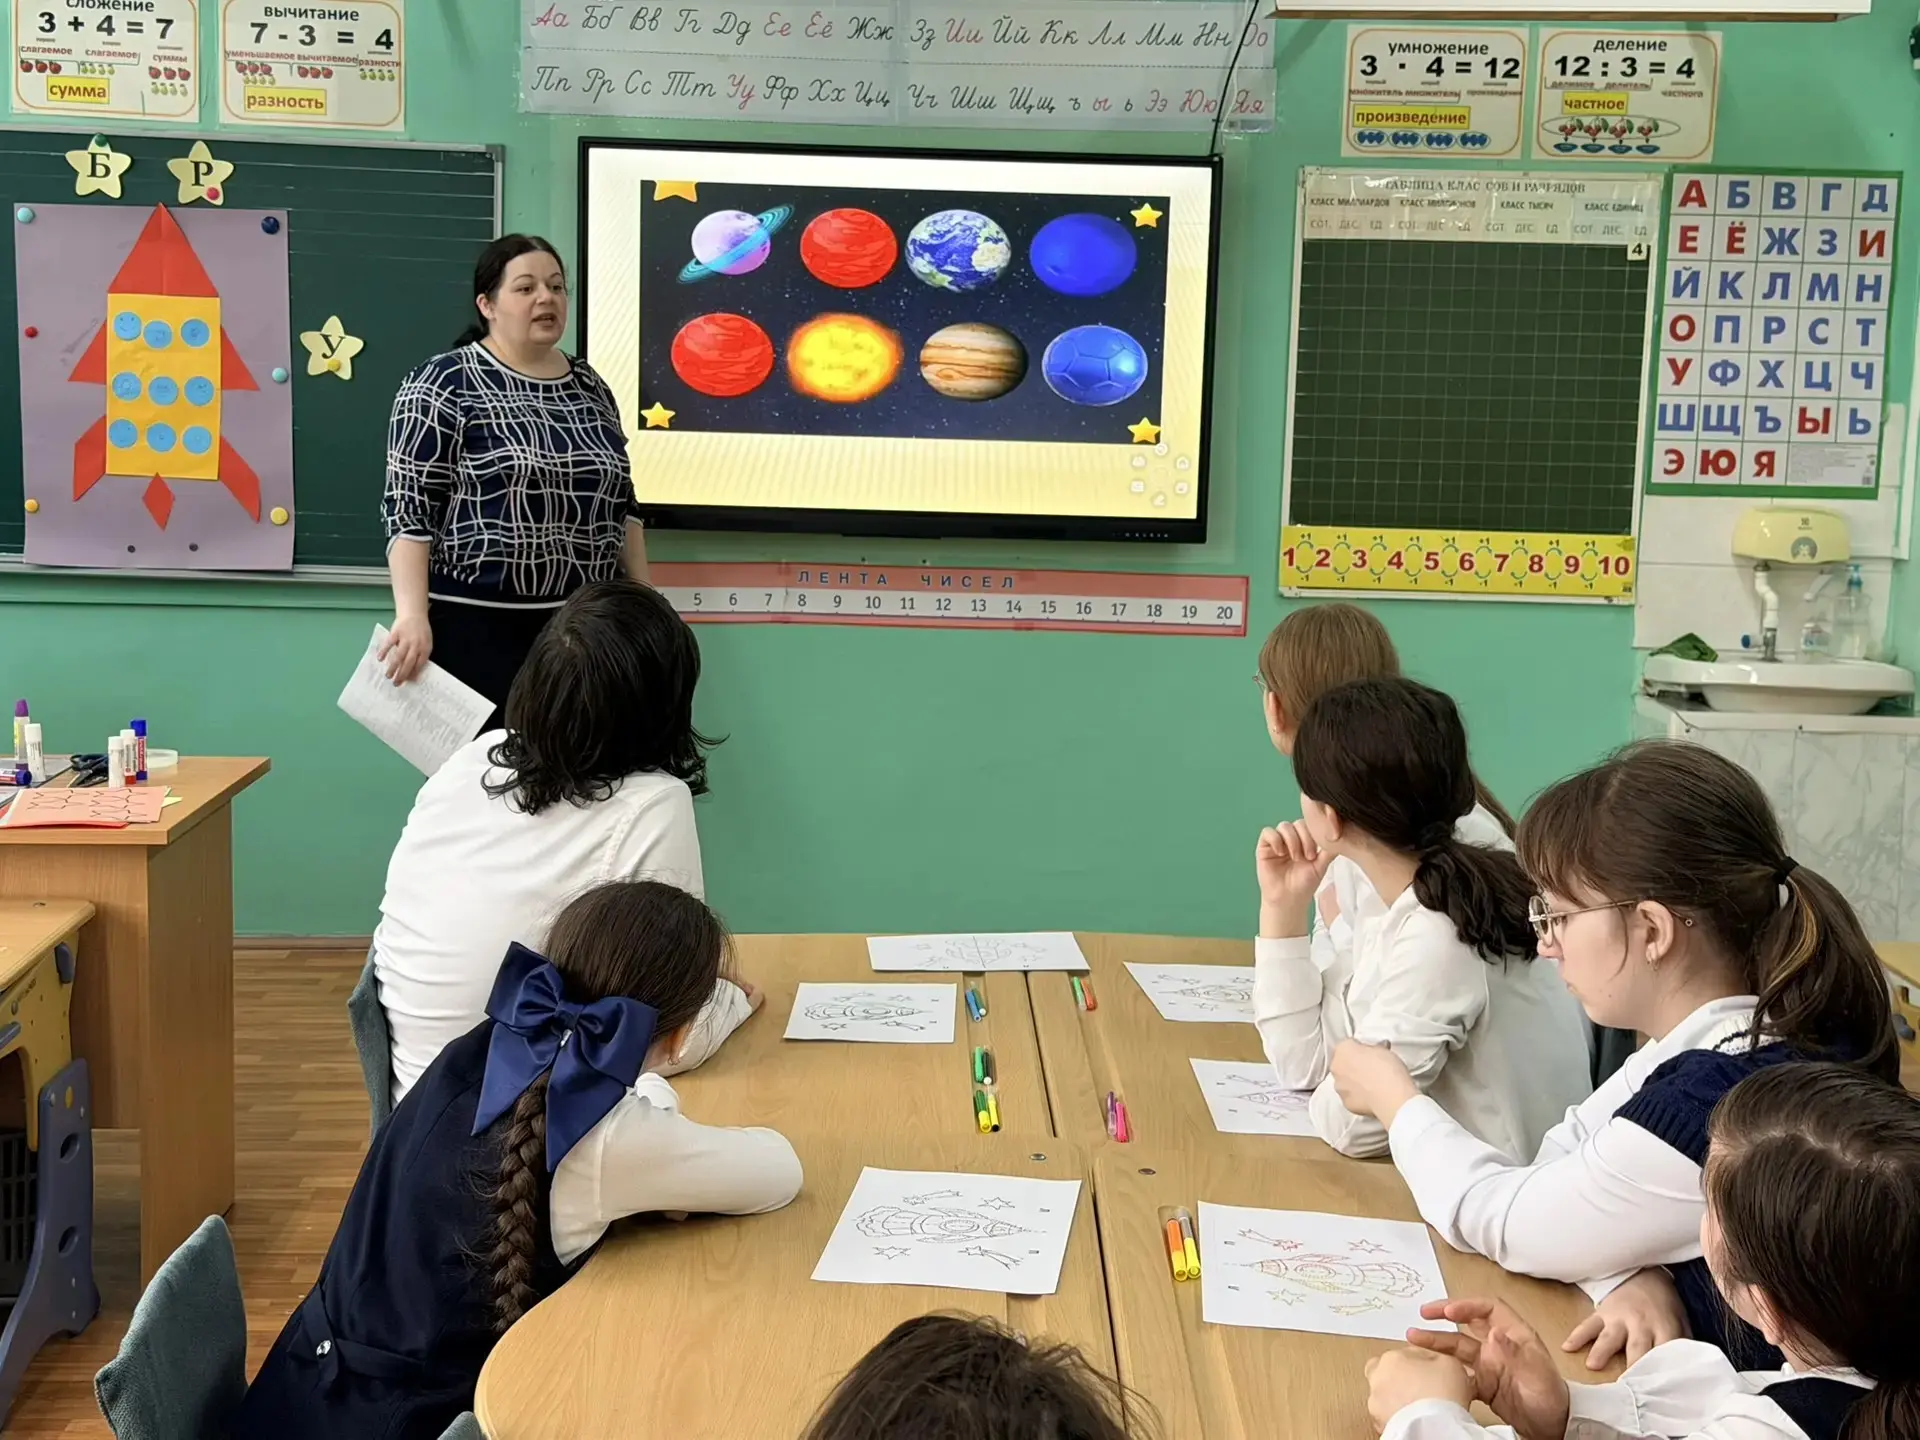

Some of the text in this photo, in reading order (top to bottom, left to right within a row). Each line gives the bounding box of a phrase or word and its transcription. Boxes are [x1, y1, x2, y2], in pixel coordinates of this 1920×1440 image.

[66, 0, 155, 12] сложение
[264, 6, 359, 21] вычитание
[38, 11, 56, 33] 3
[96, 15, 116, 36] 4
[155, 18, 174, 39] 7
[250, 22, 268, 44] 7
[298, 25, 316, 46] 3
[375, 29, 394, 50] 4
[531, 3, 569, 27] Аа
[582, 5, 622, 29] Бб
[630, 7, 662, 31] Вв
[674, 9, 701, 33] Гг
[713, 11, 752, 45] Дд
[763, 12, 792, 37] Ее
[805, 10, 833, 38] Ёё
[847, 16, 893, 41] Жж
[910, 19, 936, 50] Зз
[945, 18, 983, 44] Ии
[992, 14, 1030, 44] Йй
[1040, 19, 1079, 44] Кк
[1088, 20, 1126, 46] Лл
[1136, 23, 1184, 47] Мм
[1193, 22, 1231, 47] Нн
[21, 46, 73, 55] слагаемое
[85, 49, 138, 59] слагаемое
[1388, 42, 1489, 56] умножение
[1593, 40, 1667, 53] деление
[1360, 55, 1377, 76] 3
[1425, 57, 1444, 77] 4
[1484, 57, 1520, 79] 12
[1554, 56, 1591, 77] 12
[1620, 57, 1638, 78] 3
[1676, 58, 1695, 79] 4
[50, 85, 107, 100] сумма
[247, 95, 324, 109] разность
[531, 66, 571, 93] Пп
[582, 68, 615, 103] Рр
[625, 70, 652, 96] Сс
[662, 71, 717, 97] Тт
[727, 73, 755, 109] Уу
[763, 75, 799, 110] Фф
[808, 79, 846, 102] Хх
[855, 81, 890, 107] Цц
[907, 84, 938, 108] Чч
[950, 86, 997, 109] Шш
[1009, 87, 1055, 113] Щщ
[1068, 98, 1081, 111] ъ
[1092, 98, 1112, 112] ы
[1145, 90, 1168, 113] Ээ
[1179, 89, 1218, 113] Юю
[1231, 89, 1264, 113] Яя
[1564, 99, 1625, 110] частное
[1356, 111, 1467, 126] произведение
[87, 152, 214, 187] Б Р
[1678, 180, 1888, 212] А Б В Г Д
[1631, 243, 1643, 255] 4
[1678, 221, 1885, 258] Е Ё Ж З И
[1671, 266, 1882, 302] Й К Л М Н
[1669, 314, 1876, 346] О П Р С Т
[320, 334, 345, 360] У
[1667, 358, 1874, 391] У Ф Х Ц Ч
[1658, 404, 1871, 436] Ш Щ Ъ Ы Ь
[1663, 448, 1684, 475] Э
[1699, 449, 1736, 476] Ю
[1753, 450, 1776, 477] Я
[1283, 547, 1630, 576] 1 2 3 4 5 6 7 8 9 10
[798, 571, 1013, 589] ЛЕНТА ЧИСЕЛ
[694, 593, 1232, 619] 5 6 7 8 9 10 11 12 13 14 15 16 17 18 19 20
